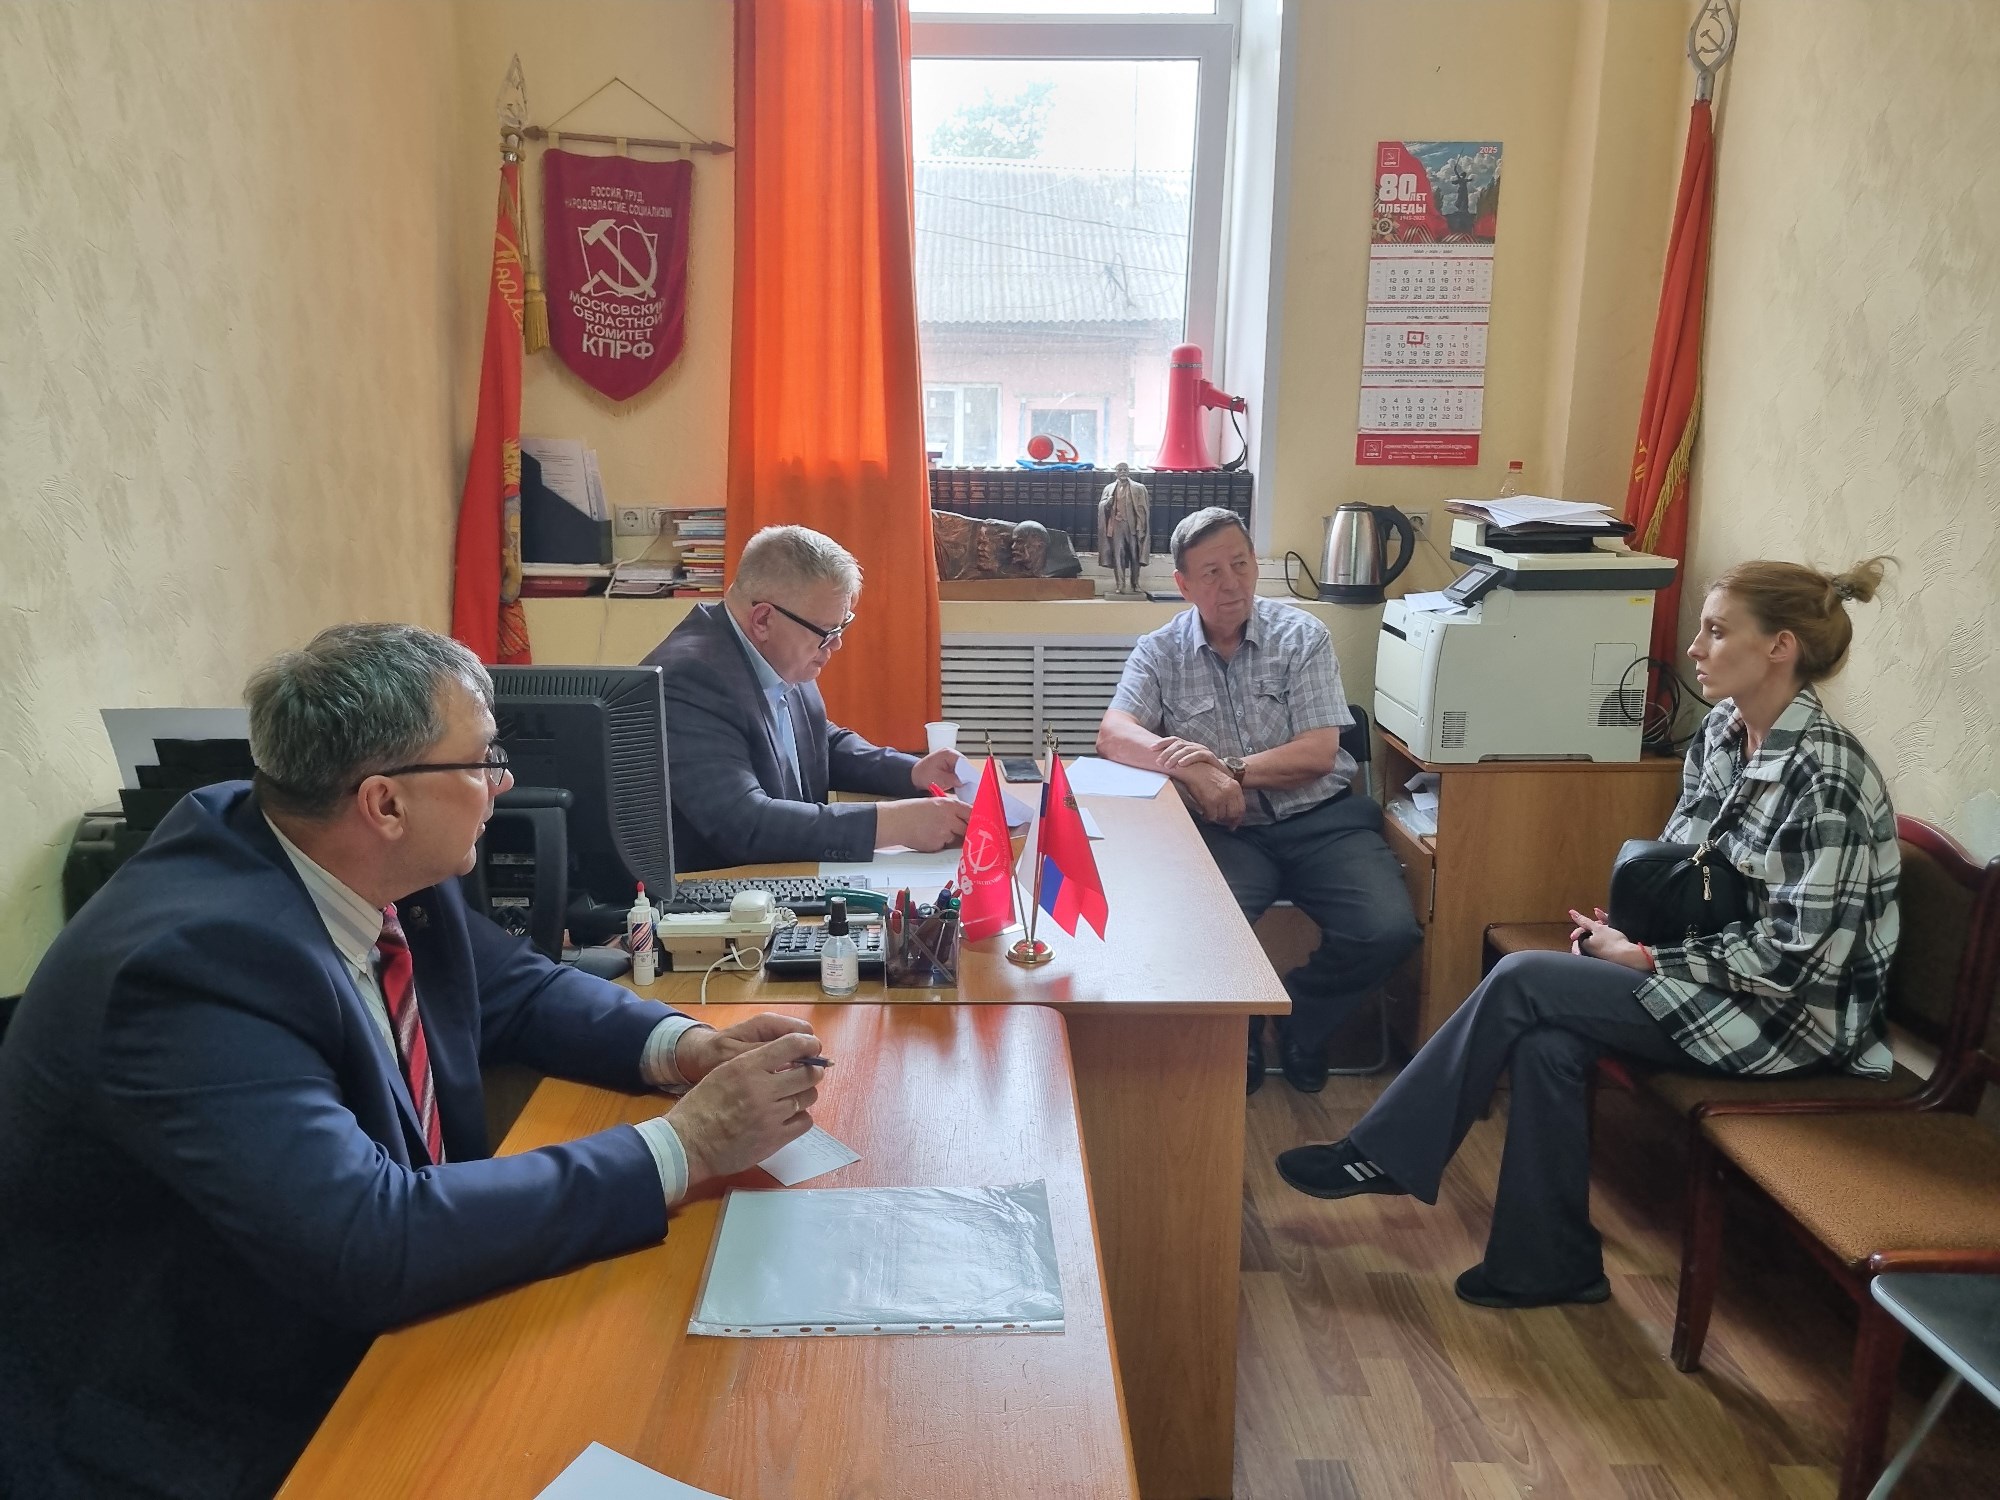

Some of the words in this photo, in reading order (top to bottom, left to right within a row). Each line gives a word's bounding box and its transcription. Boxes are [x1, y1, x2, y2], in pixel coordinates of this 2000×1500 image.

[1479, 146, 1498, 154] 2025
[590, 186, 623, 200] РОССИЯ,
[1379, 173, 1417, 202] 80
[1409, 192, 1428, 202] ЛЕТ
[1377, 203, 1427, 215] ПОБЕДЫ
[585, 321, 654, 340] КОМИТЕТ
[582, 333, 655, 360] КПРФ
